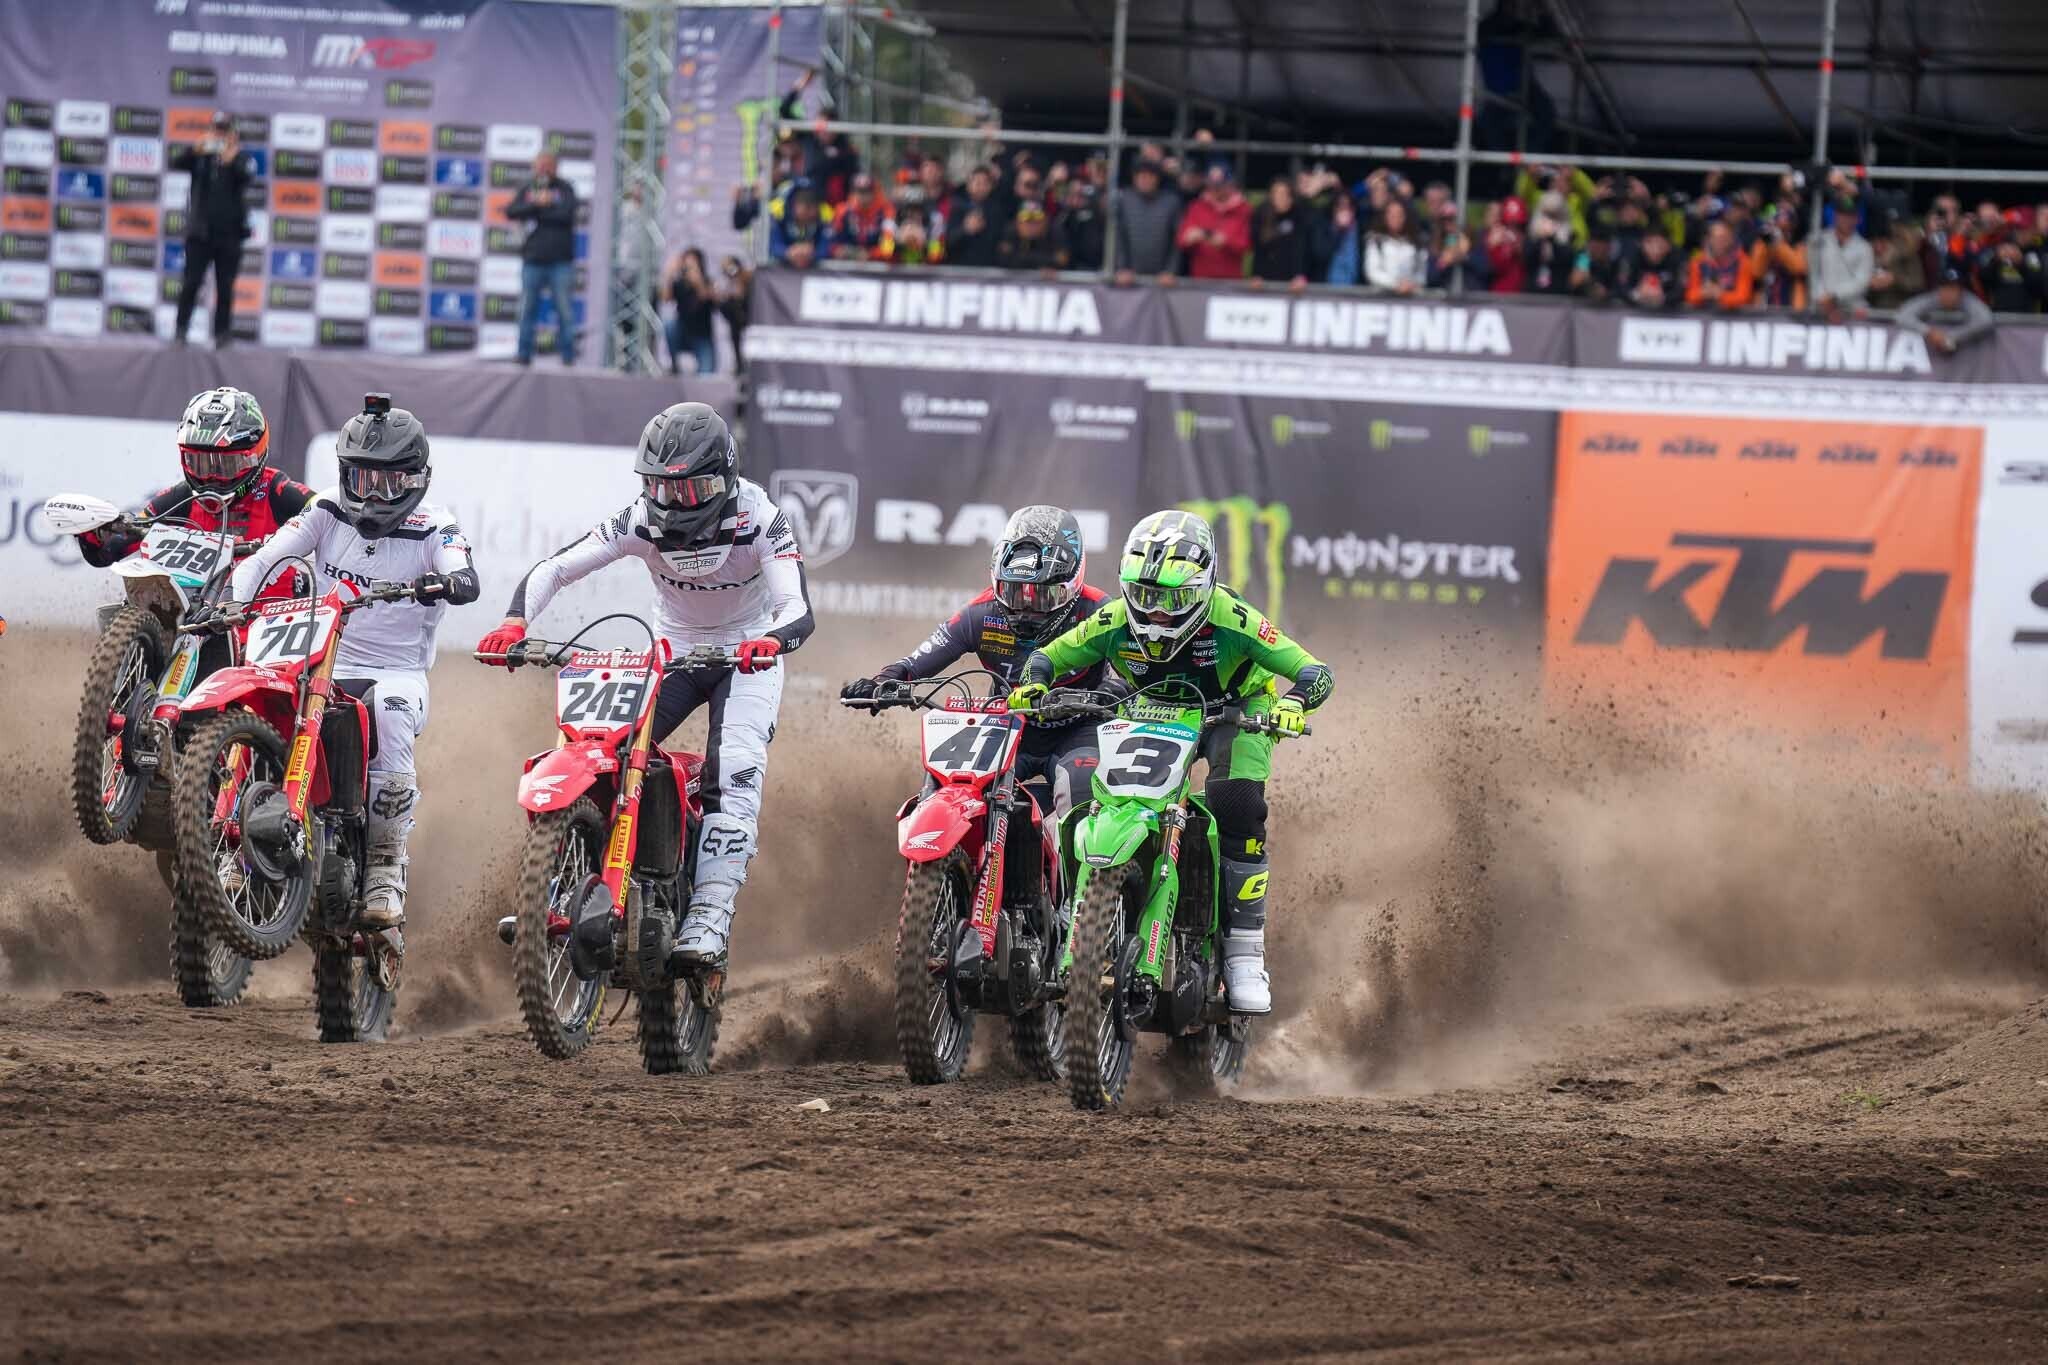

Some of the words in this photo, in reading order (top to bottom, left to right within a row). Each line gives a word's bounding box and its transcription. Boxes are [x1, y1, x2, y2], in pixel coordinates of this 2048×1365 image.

[884, 280, 1101, 335] INFINIA
[1292, 300, 1512, 355] INFINIA
[1707, 321, 1932, 373] INFINIA
[150, 539, 218, 574] 259
[1292, 532, 1520, 584] MONSTER
[1572, 531, 1951, 661] KTM
[254, 622, 320, 662] 70
[575, 657, 646, 665] RENHAL
[787, 637, 800, 649] FOX
[561, 682, 643, 723] 243
[1102, 723, 1130, 732] MXGP
[1156, 726, 1195, 738] MOTOREX
[289, 739, 308, 777] PIRELLI
[928, 727, 1009, 771] 41
[1107, 737, 1182, 787] 3
[297, 772, 310, 808] ACERBIS
[612, 819, 629, 863] PIRELLI
[906, 842, 941, 851] HONDA
[620, 862, 631, 904] ACERBIS
[984, 892, 994, 924] ACERBIS
[1147, 920, 1160, 963] BRAKING
[1158, 889, 1175, 969] DUNLOP
